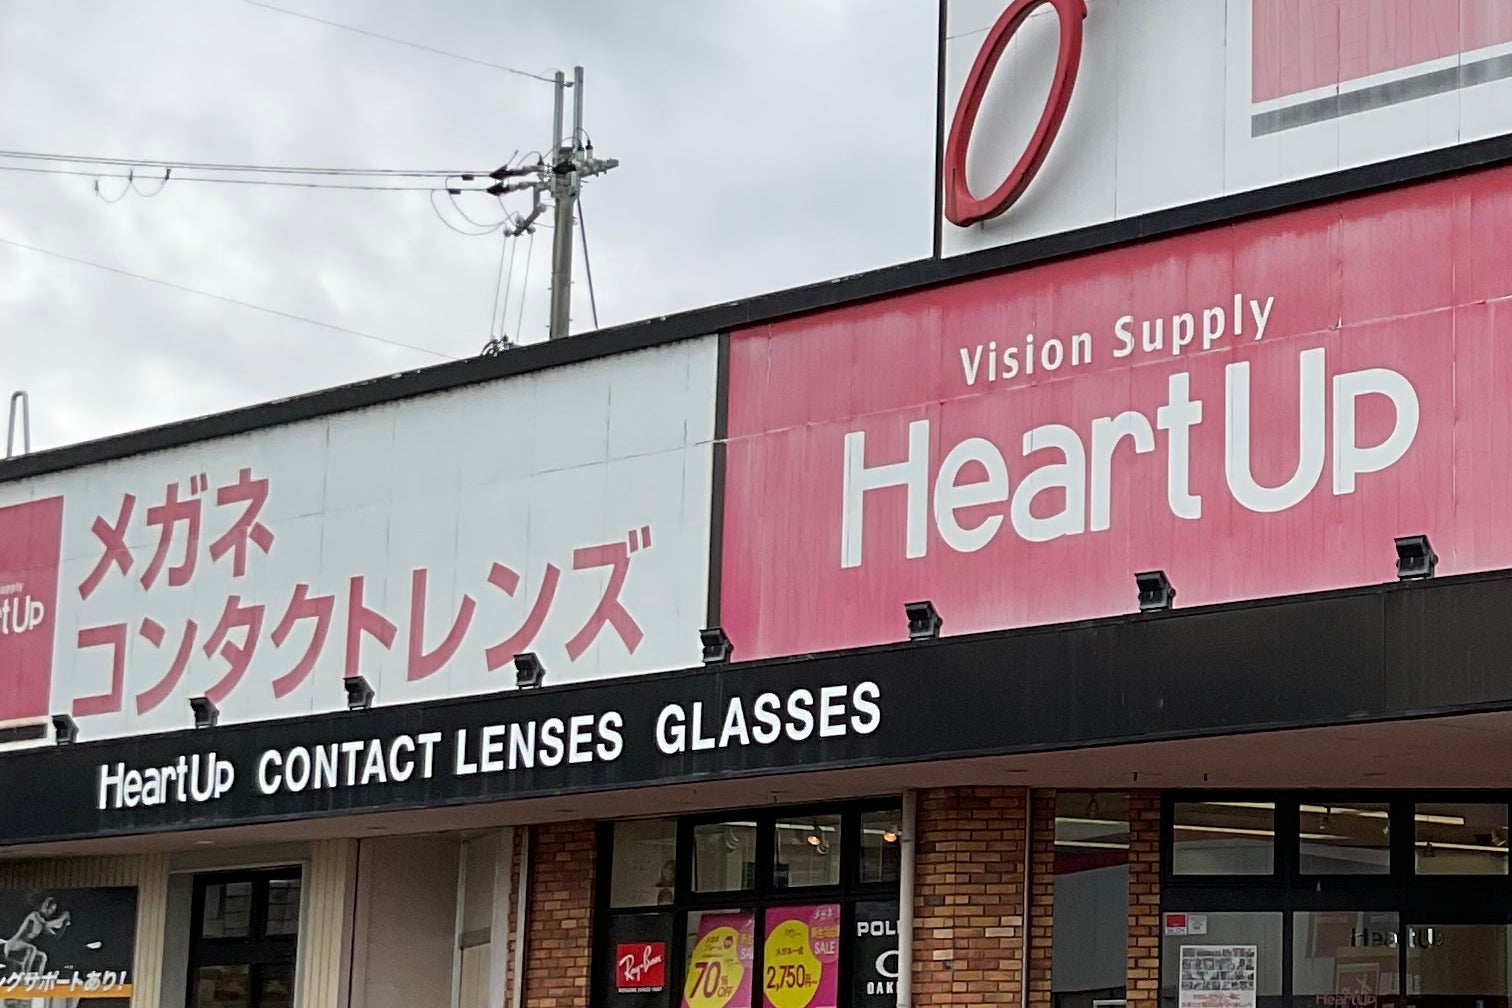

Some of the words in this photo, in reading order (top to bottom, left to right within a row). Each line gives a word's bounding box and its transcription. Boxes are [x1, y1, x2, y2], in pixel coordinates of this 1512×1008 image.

[960, 333, 1092, 386] Vision
[1112, 294, 1275, 357] Supply
[841, 347, 1420, 568] HeartUp
[78, 467, 274, 600] メガネ
[0, 594, 45, 635] tUp
[72, 526, 652, 717] コンタクトレンズ
[98, 752, 235, 810] HeartUp
[257, 732, 441, 795] CONTACT
[455, 711, 624, 775] LENSES
[656, 683, 881, 754] GLASSES
[618, 945, 662, 981] Ray-Ban
[767, 965, 805, 991] 2,750
[814, 941, 836, 954] SALE
[717, 986, 734, 998] OFF
